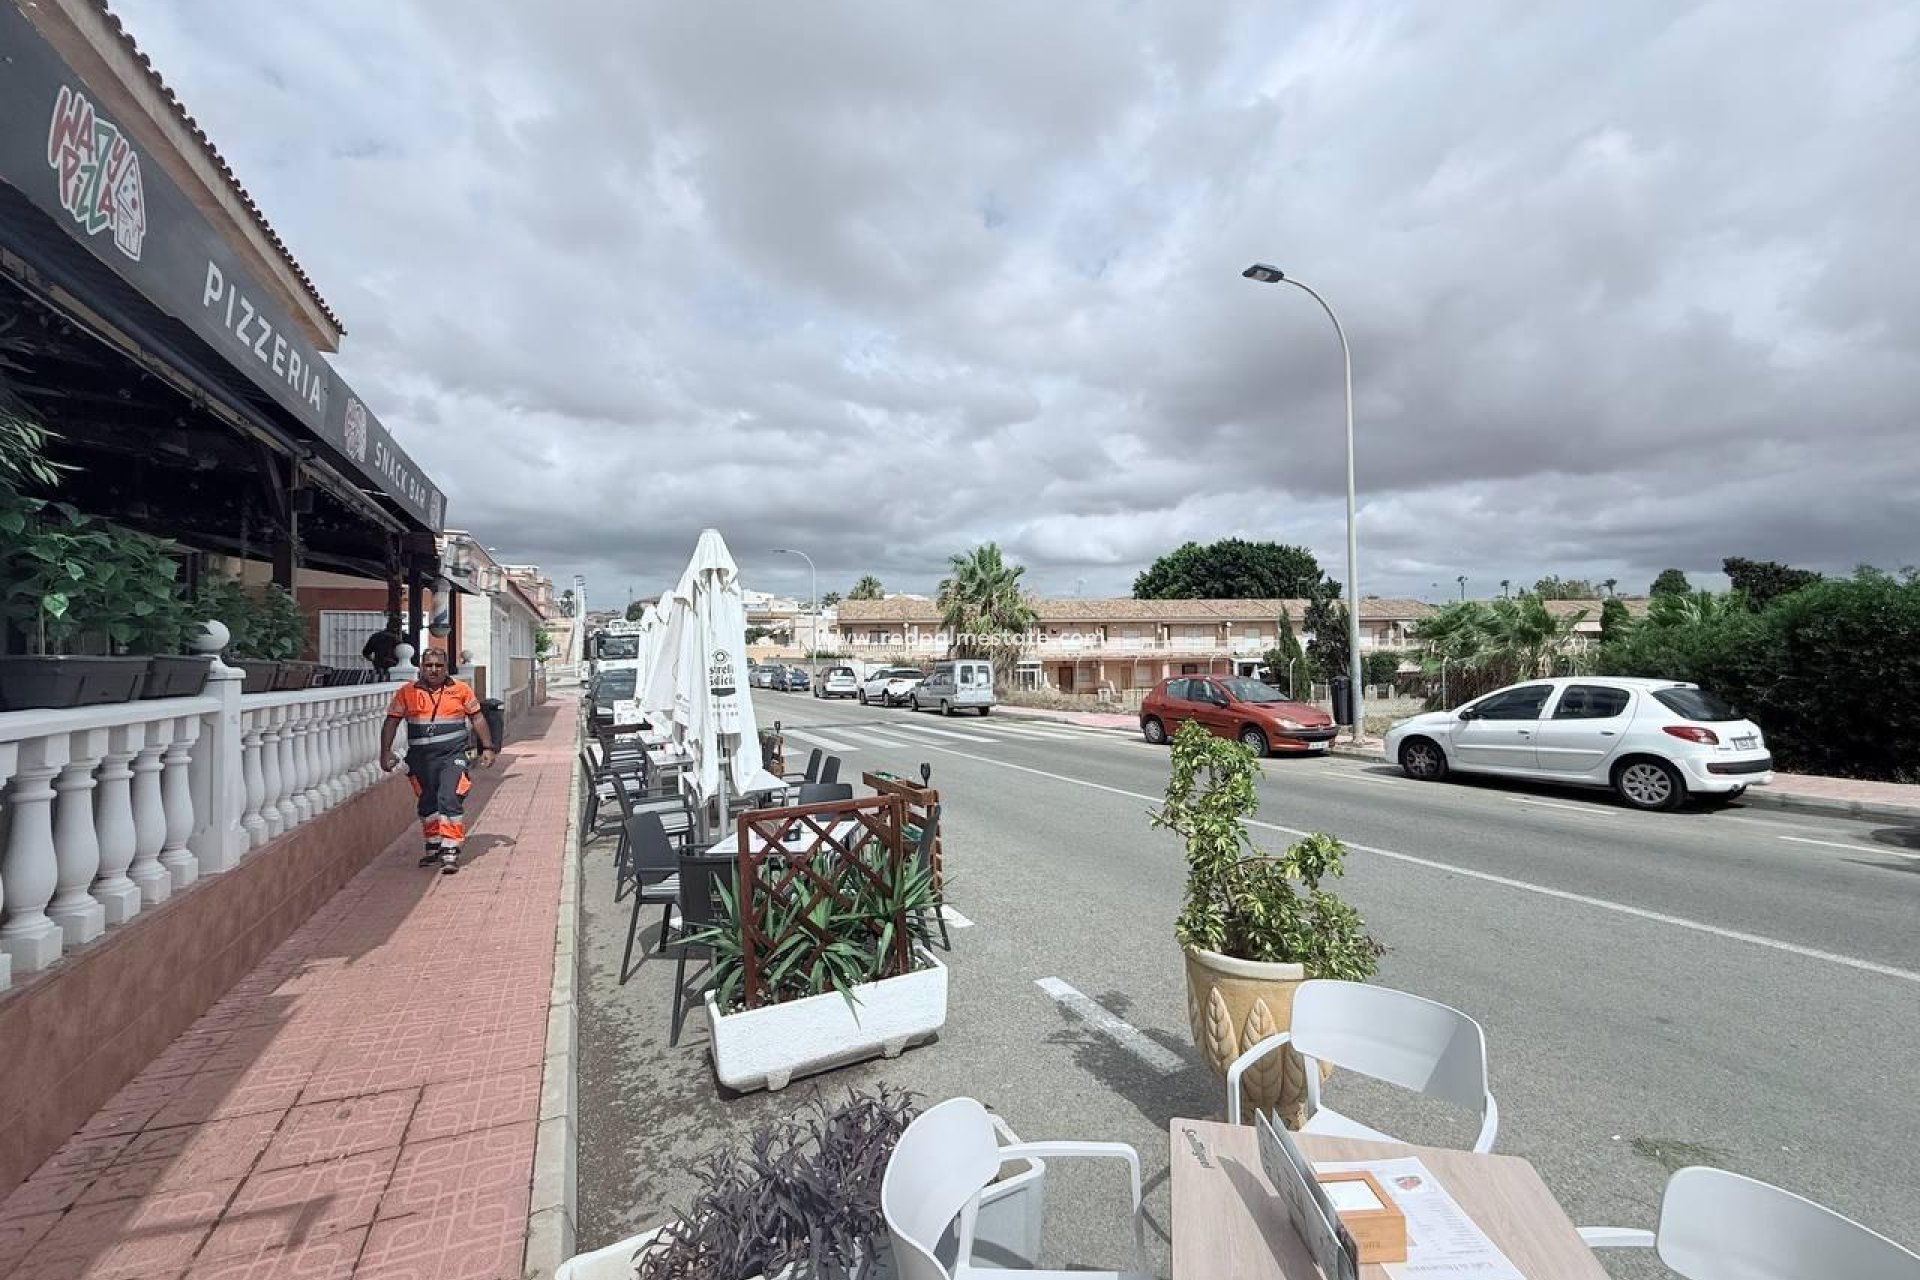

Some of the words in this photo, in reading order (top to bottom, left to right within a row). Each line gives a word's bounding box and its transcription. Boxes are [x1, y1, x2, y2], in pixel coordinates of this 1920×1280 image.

[203, 259, 321, 413] PIZZERIA
[374, 441, 408, 493] SNACK
[409, 477, 427, 510] BAR
